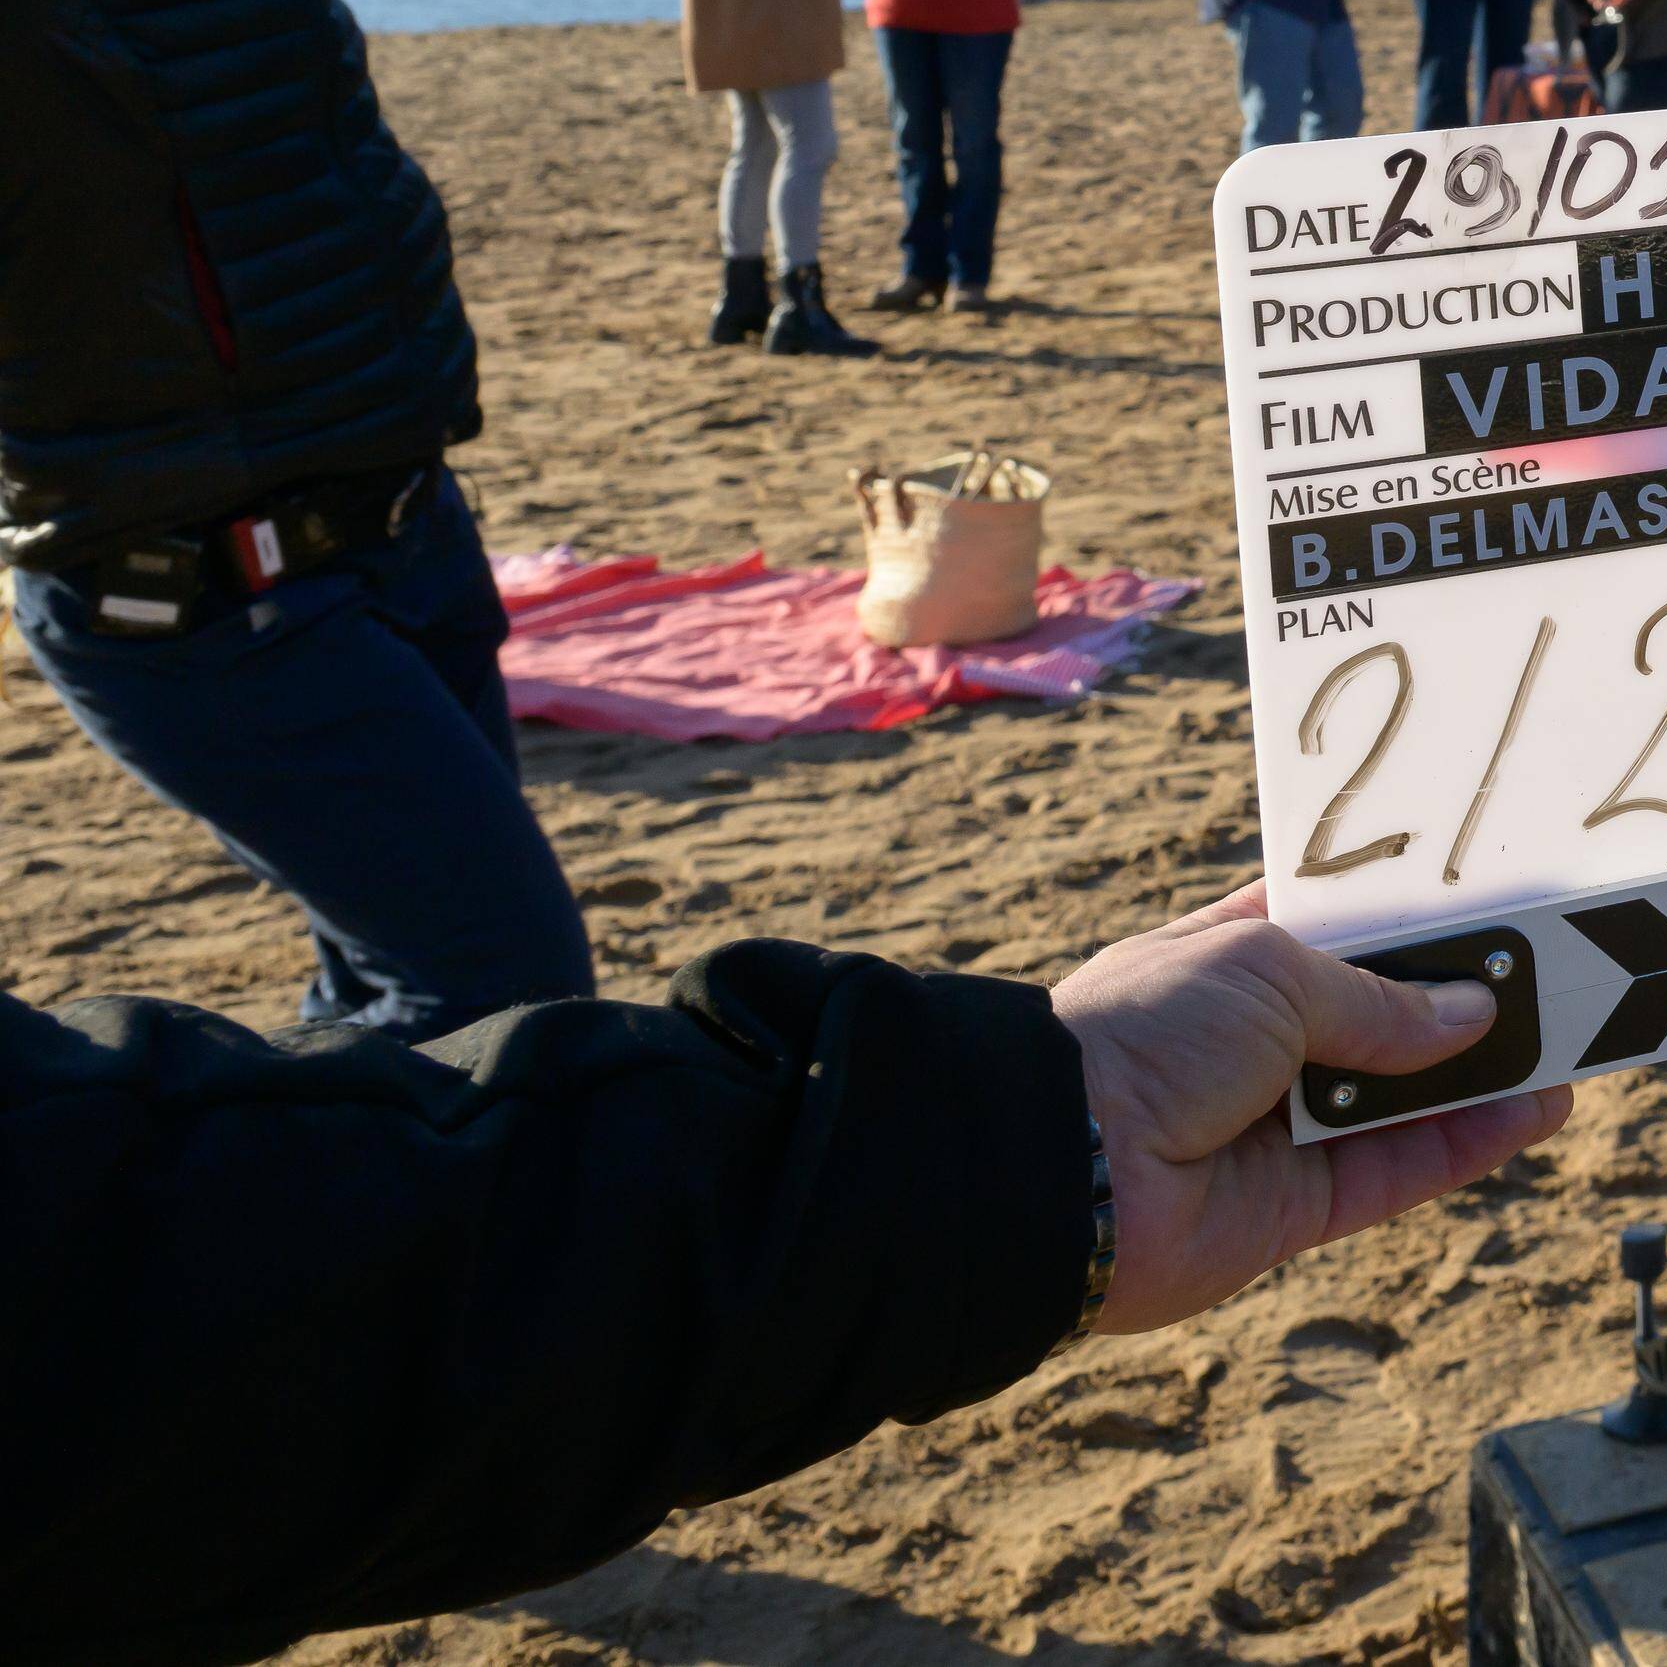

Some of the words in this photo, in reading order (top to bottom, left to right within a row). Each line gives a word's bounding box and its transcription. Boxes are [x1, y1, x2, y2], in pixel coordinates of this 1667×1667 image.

[1245, 203, 1372, 254] DATE
[1252, 274, 1575, 347] PRODUCTION
[1260, 400, 1375, 450] FILM
[1269, 482, 1358, 520] Mise
[1372, 474, 1418, 504] en
[1431, 457, 1541, 496] Scène
[1276, 597, 1375, 642] PLAN
